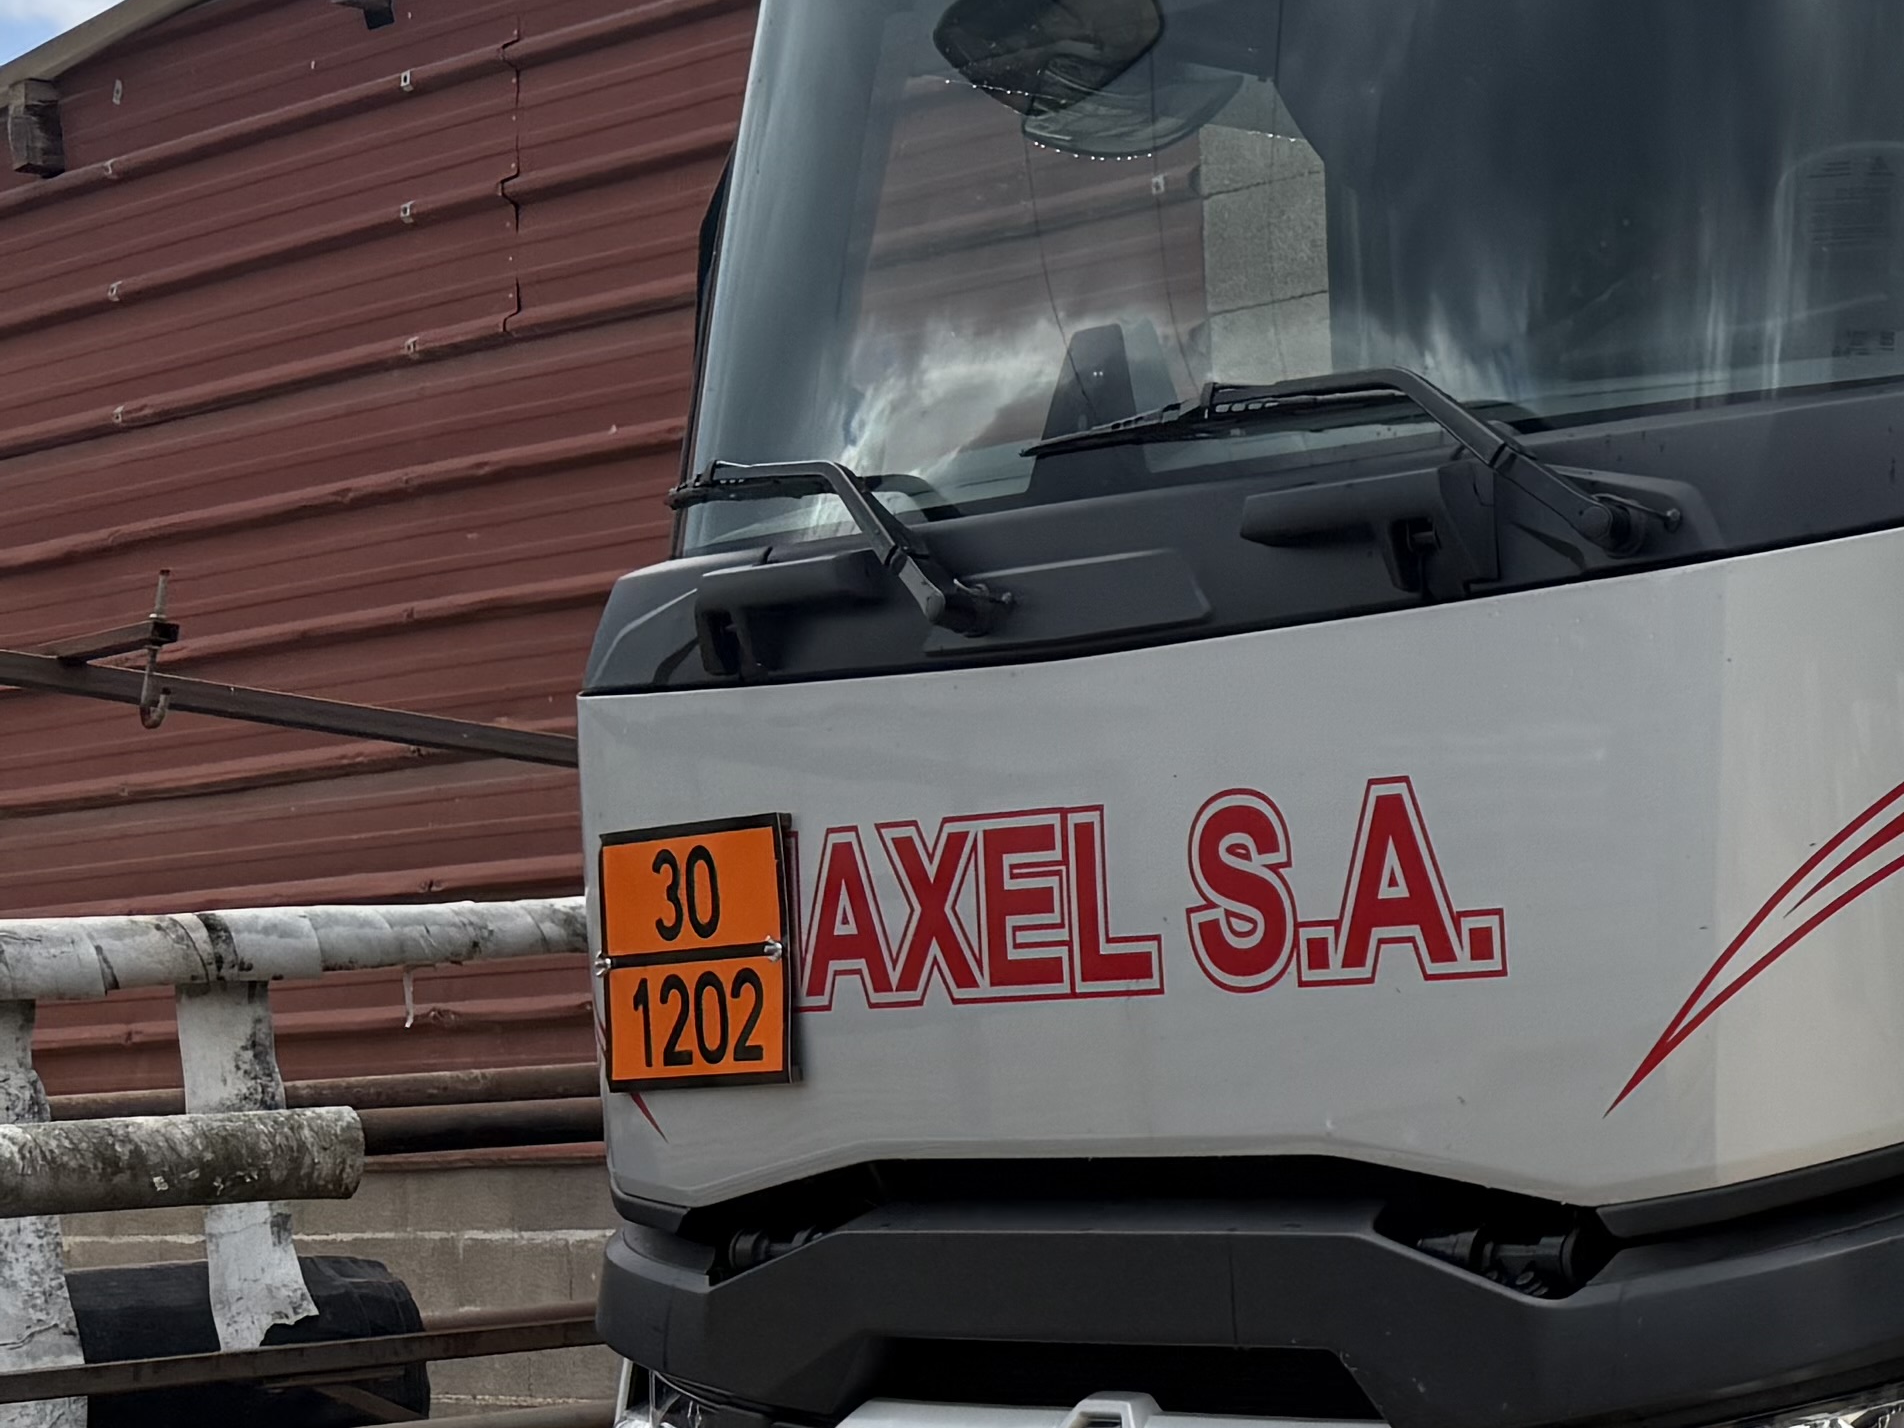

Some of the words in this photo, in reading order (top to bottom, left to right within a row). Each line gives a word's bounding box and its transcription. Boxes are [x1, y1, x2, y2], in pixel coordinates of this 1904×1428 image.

[651, 844, 720, 943] 30
[790, 803, 1165, 1012] AXEL
[1185, 775, 1508, 993] S.A.
[631, 966, 764, 1069] 1202
